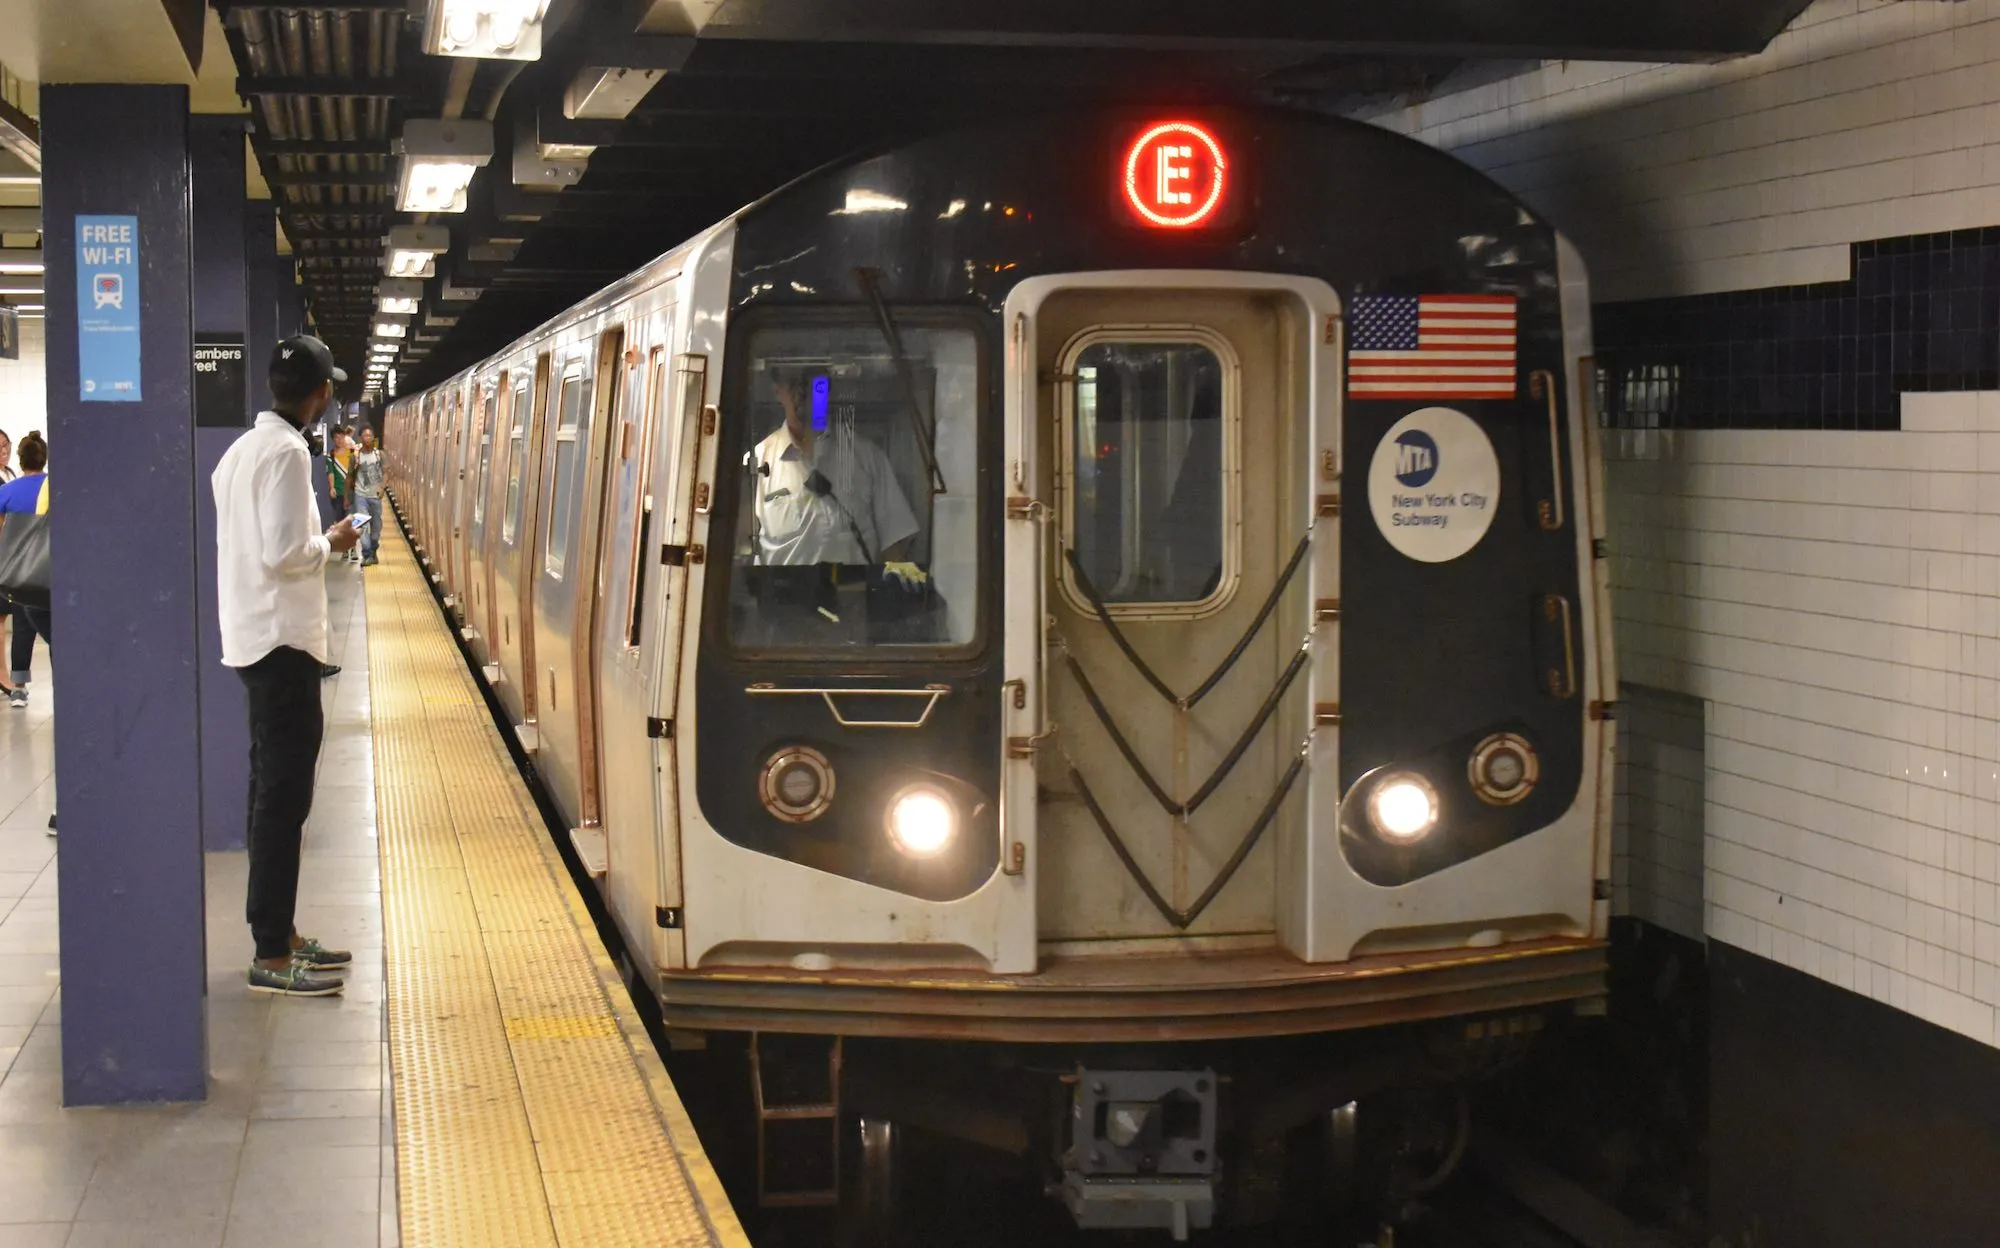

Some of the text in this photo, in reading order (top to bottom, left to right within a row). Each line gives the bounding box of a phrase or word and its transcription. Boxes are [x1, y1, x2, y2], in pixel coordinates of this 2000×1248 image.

[1157, 146, 1192, 204] E
[83, 225, 131, 243] FREE
[83, 247, 131, 264] WI-FI
[195, 347, 242, 360] ambers
[1394, 441, 1434, 477] MTA
[1392, 492, 1488, 510] New York City
[1392, 512, 1448, 529] Subway
